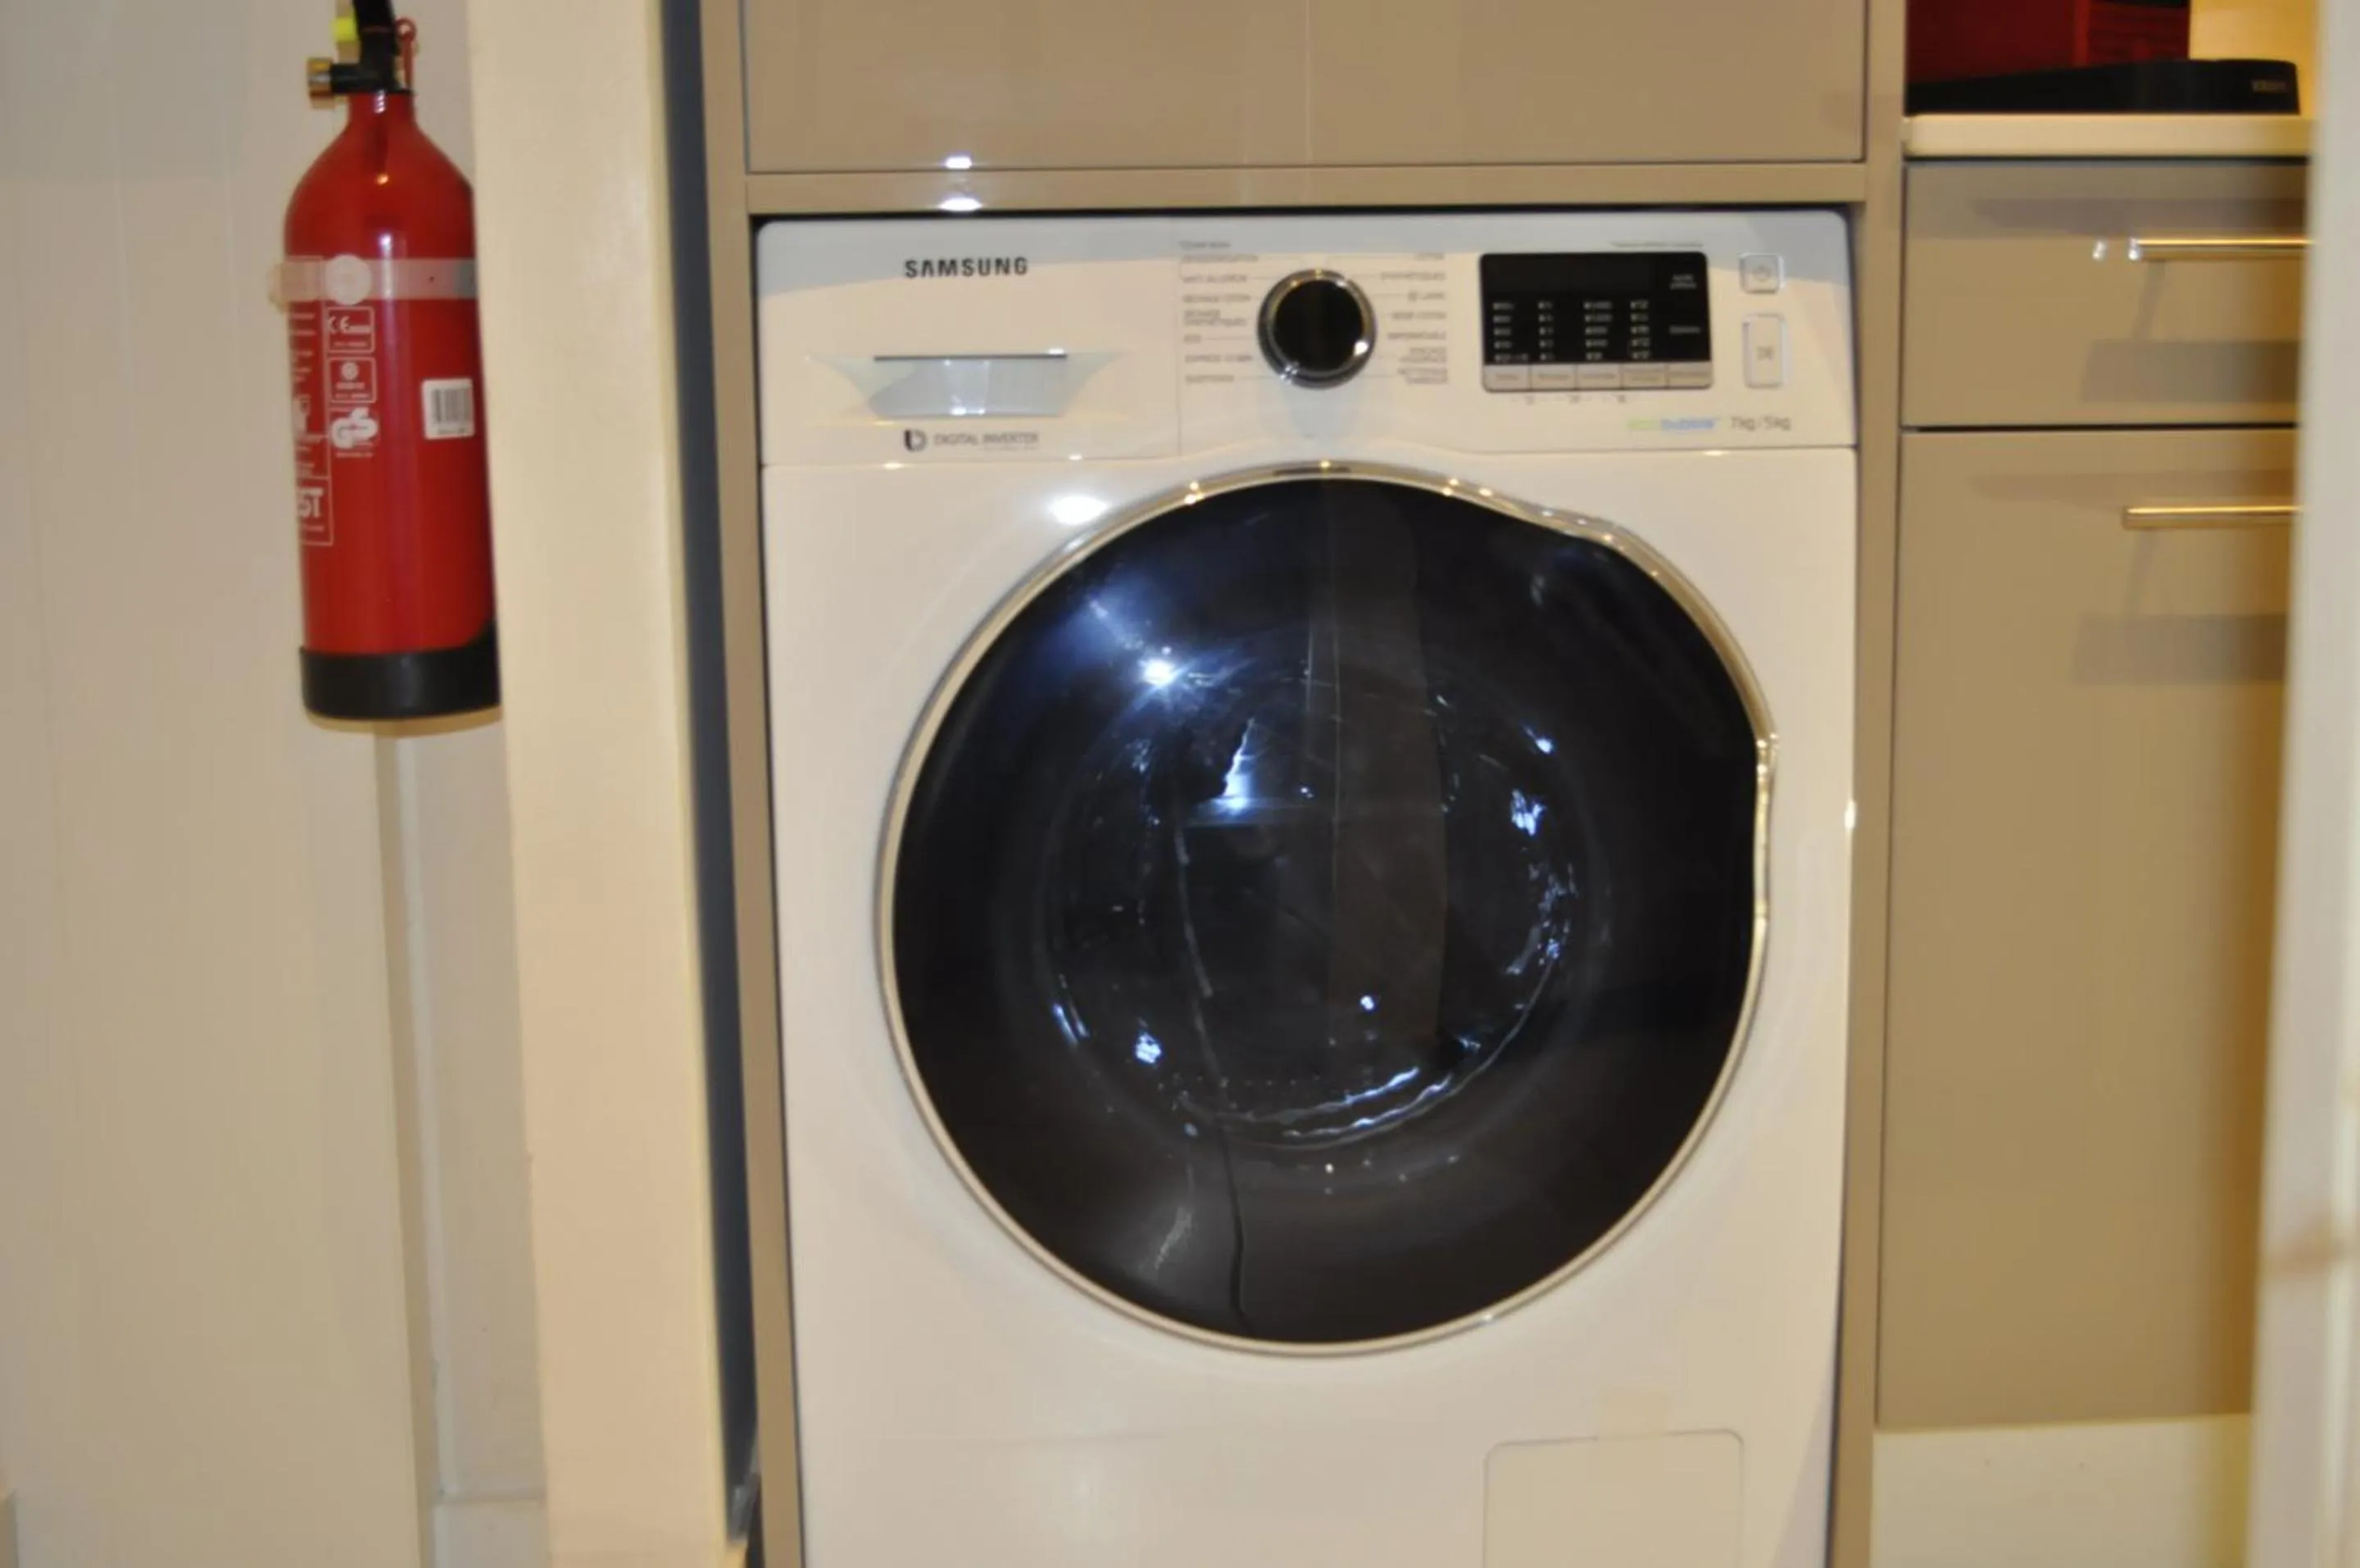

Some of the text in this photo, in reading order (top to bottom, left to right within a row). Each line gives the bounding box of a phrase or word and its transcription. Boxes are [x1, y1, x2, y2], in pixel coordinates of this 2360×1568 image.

[905, 256, 1028, 279] SAMSUNG
[934, 432, 1040, 446] DIGITAL INVERTER
